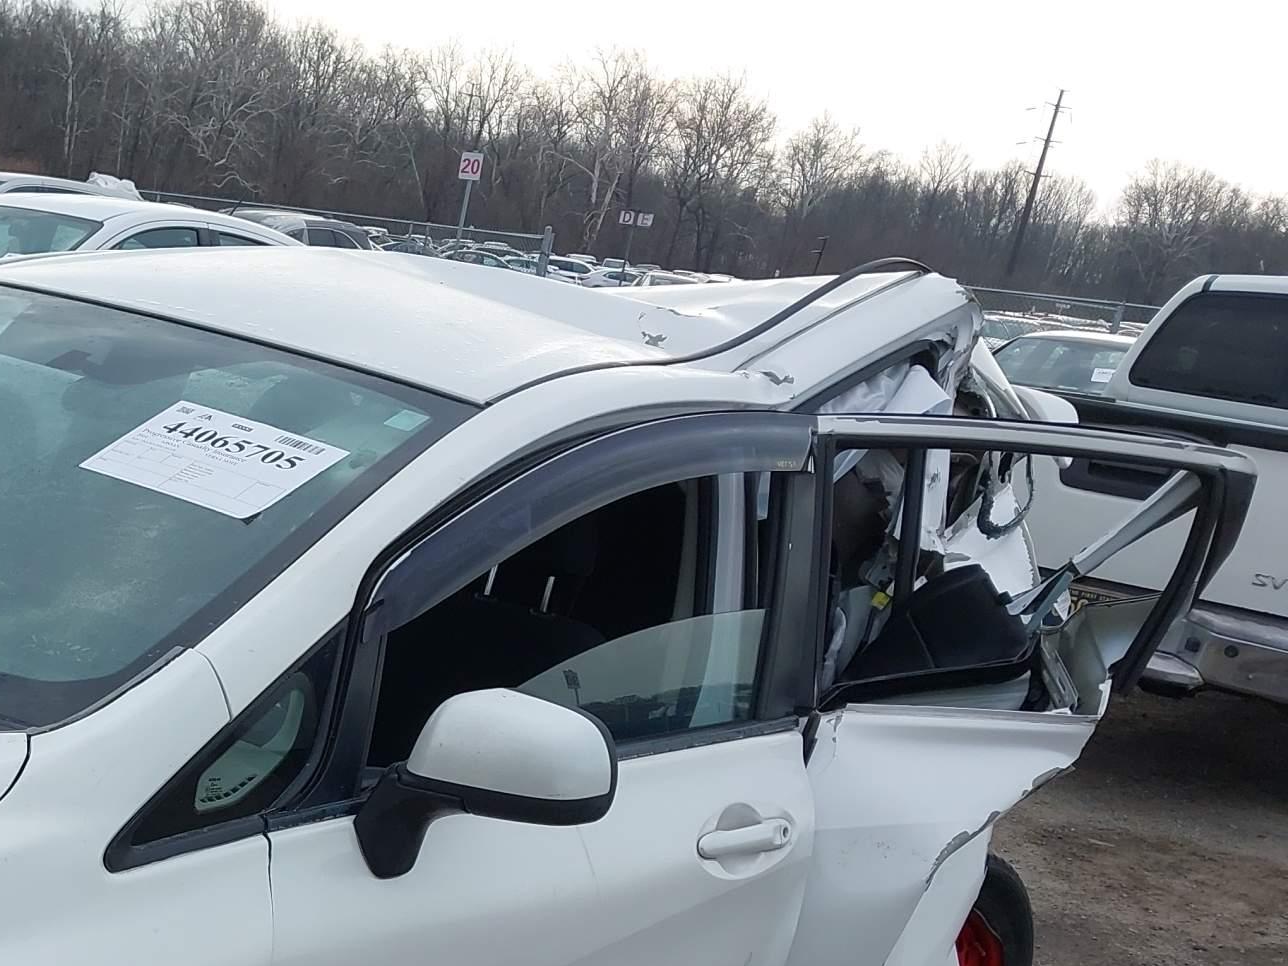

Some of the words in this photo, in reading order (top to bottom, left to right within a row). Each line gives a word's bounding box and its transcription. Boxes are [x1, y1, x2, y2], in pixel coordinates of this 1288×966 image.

[460, 158, 480, 175] 20
[623, 211, 632, 222] D
[640, 213, 650, 225] E
[162, 421, 306, 470] 44065705
[183, 440, 210, 453] Casualty
[213, 449, 248, 463] Insurance
[1252, 573, 1288, 590] SV
